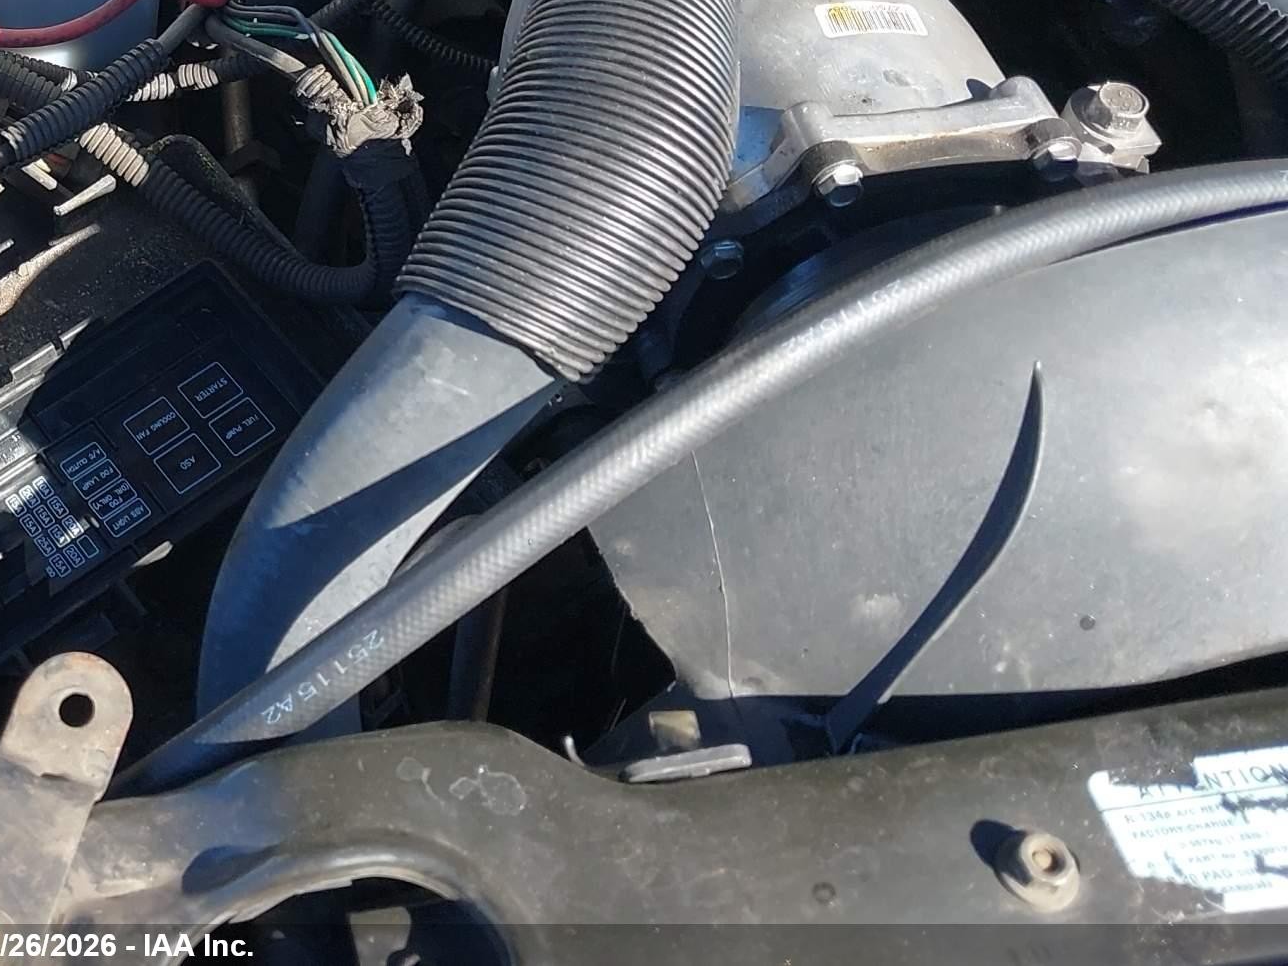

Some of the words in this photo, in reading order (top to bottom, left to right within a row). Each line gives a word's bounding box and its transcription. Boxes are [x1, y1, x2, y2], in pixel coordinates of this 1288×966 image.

[195, 377, 227, 402] STARTER
[51, 499, 63, 515] 15A
[37, 508, 50, 524] 15A
[24, 517, 36, 532] 15A
[67, 547, 80, 564] 20A
[53, 557, 66, 573] 15A
[259, 626, 386, 727] 25115A2
